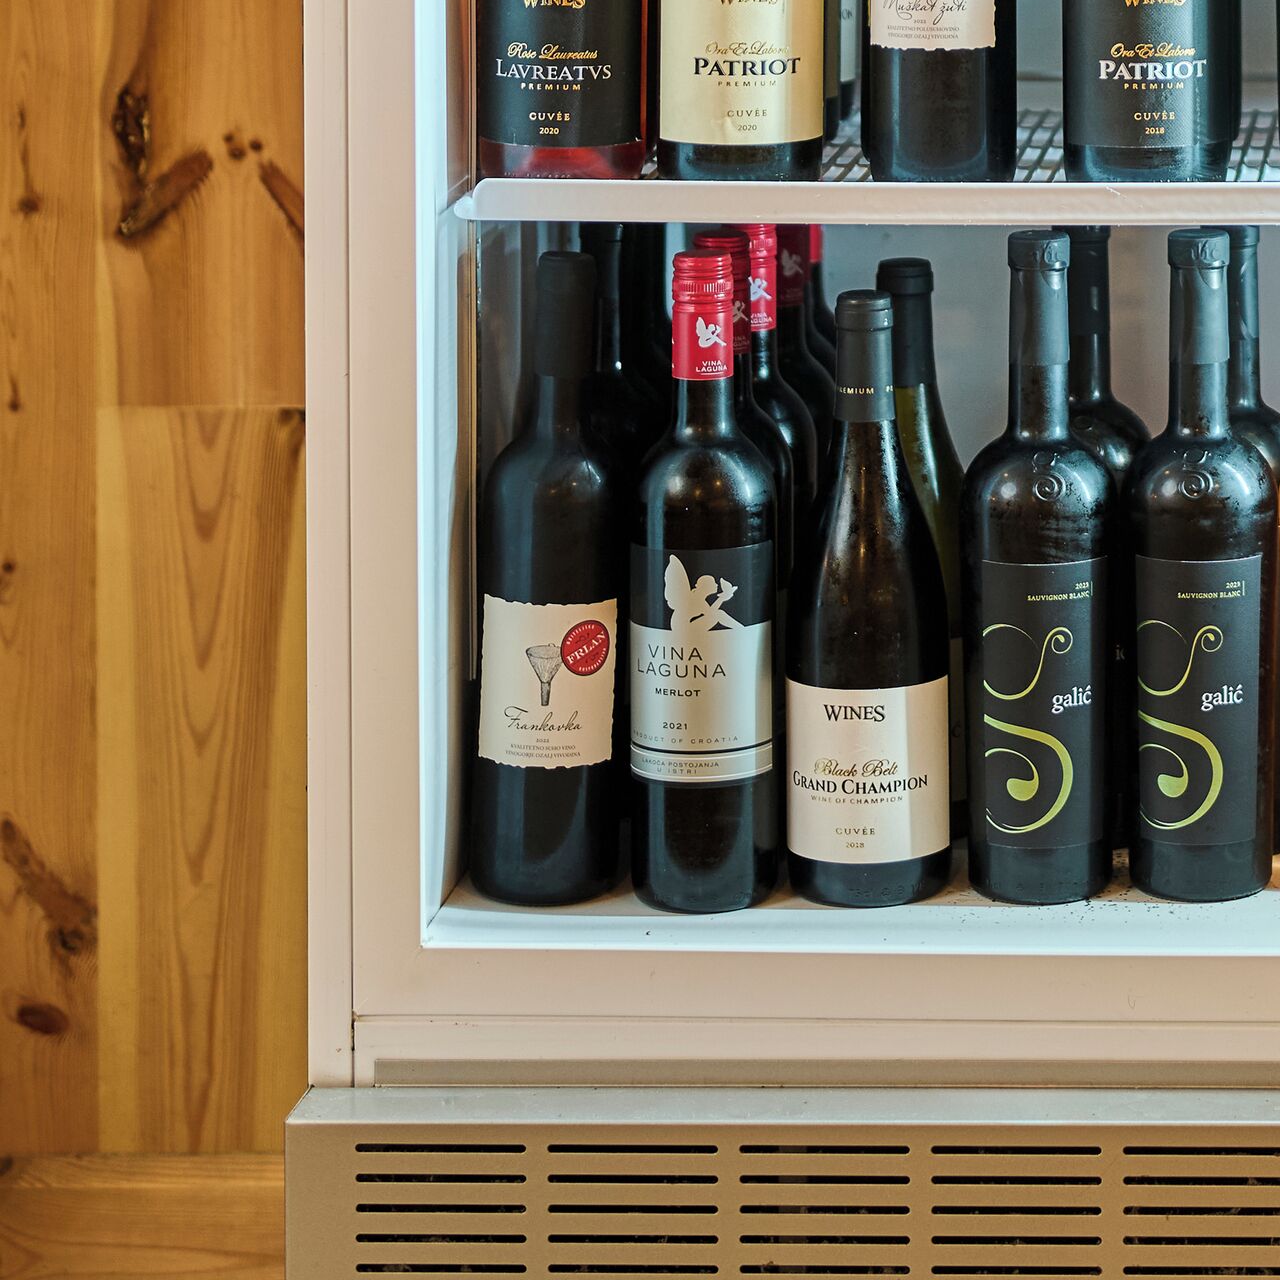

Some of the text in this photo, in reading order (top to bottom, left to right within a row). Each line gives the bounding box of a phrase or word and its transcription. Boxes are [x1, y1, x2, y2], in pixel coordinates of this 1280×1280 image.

[539, 43, 598, 60] Laureatus
[705, 41, 729, 55] Ora
[729, 42, 747, 56] Et
[1110, 42, 1196, 59] Ora Et Labora
[495, 58, 612, 81] LAVREATVS
[693, 57, 801, 76] PATRIOT
[1098, 59, 1207, 80] PATRIOT
[521, 82, 581, 91] PREMIUM
[1123, 81, 1184, 90] PREMIUM
[529, 111, 570, 121] CUVÉE
[727, 108, 768, 118] CUVÉE
[1134, 109, 1176, 121] CUVÉE
[539, 127, 560, 135] 2020
[737, 124, 757, 132] 2020
[1145, 127, 1165, 135] 2018
[695, 365, 728, 373] LAGUNA
[1027, 590, 1090, 601] SAUVIGNON BLANC
[1219, 590, 1241, 598] BLANC
[566, 630, 606, 664] FRLAN
[648, 644, 703, 661] VINA
[637, 657, 726, 679] LAGUNA
[655, 687, 702, 697] MERLOT
[1201, 683, 1244, 712] galić
[1051, 684, 1093, 714] galić
[503, 705, 583, 732] Frankovka
[823, 704, 886, 723] WINES
[662, 721, 688, 730] 2021
[690, 736, 739, 745] CROATIA
[814, 757, 899, 778] Black Belt
[793, 770, 928, 795] GRAND CHAMPION
[811, 794, 833, 803] WINE
[850, 795, 903, 805] CHAMPION
[835, 826, 876, 836] CUVÉE
